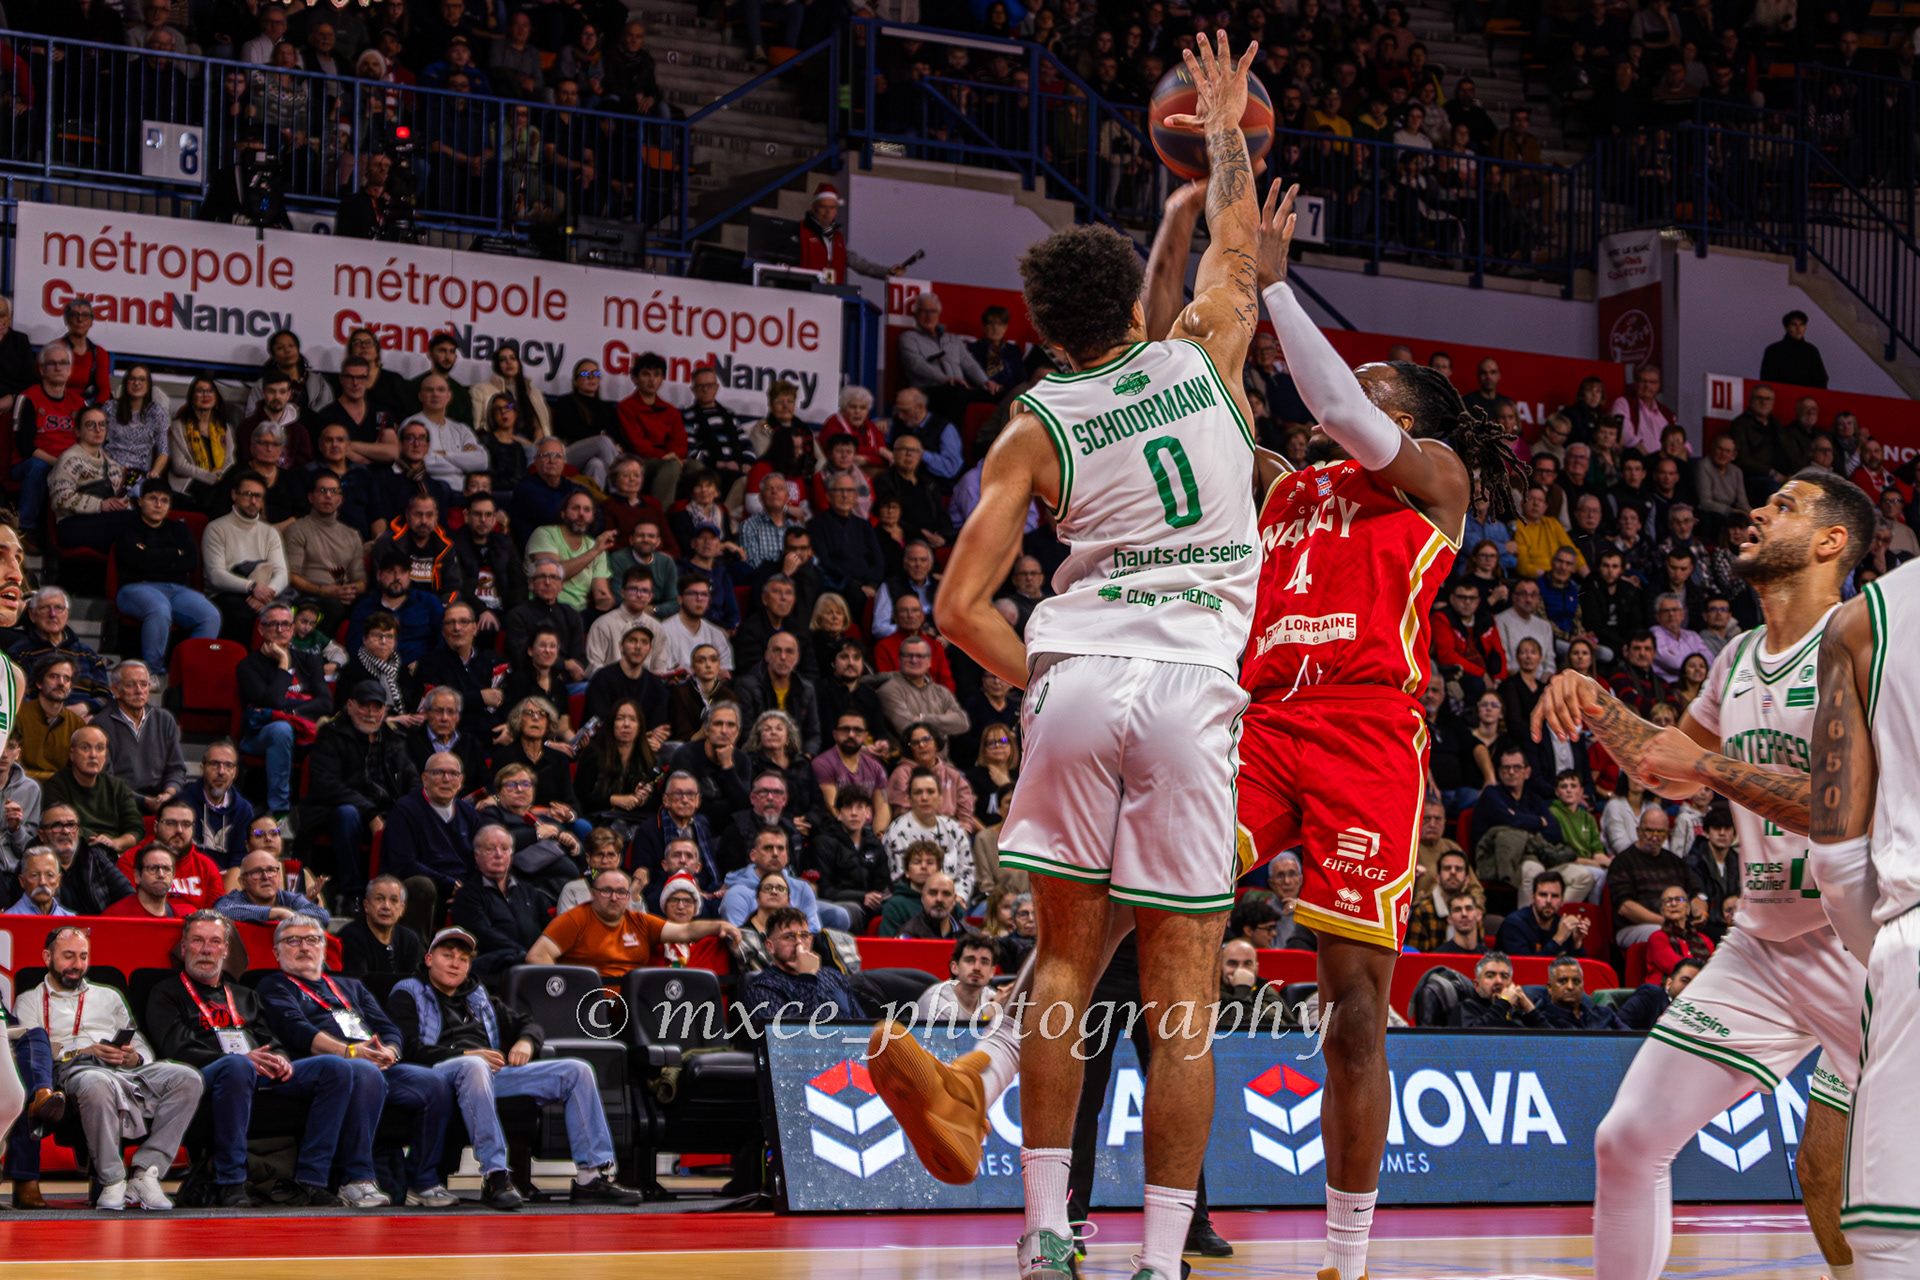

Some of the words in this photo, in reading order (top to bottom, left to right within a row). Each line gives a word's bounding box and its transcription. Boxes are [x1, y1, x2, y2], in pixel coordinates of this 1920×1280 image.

[180, 132, 198, 175] 8
[1309, 203, 1321, 236] 7
[42, 226, 294, 292] métropole
[334, 257, 568, 322] métropole
[603, 290, 819, 352] métropole
[1072, 375, 1217, 456] SCHOORMANN
[1143, 435, 1204, 529] 0
[1114, 540, 1252, 568] hauts-de-seine
[1283, 548, 1312, 594] 4
[1126, 589, 1156, 607] CLUB
[1285, 617, 1354, 632] LORRAINE
[1322, 857, 1388, 881] EIFFAGE
[1334, 900, 1361, 913] errea
